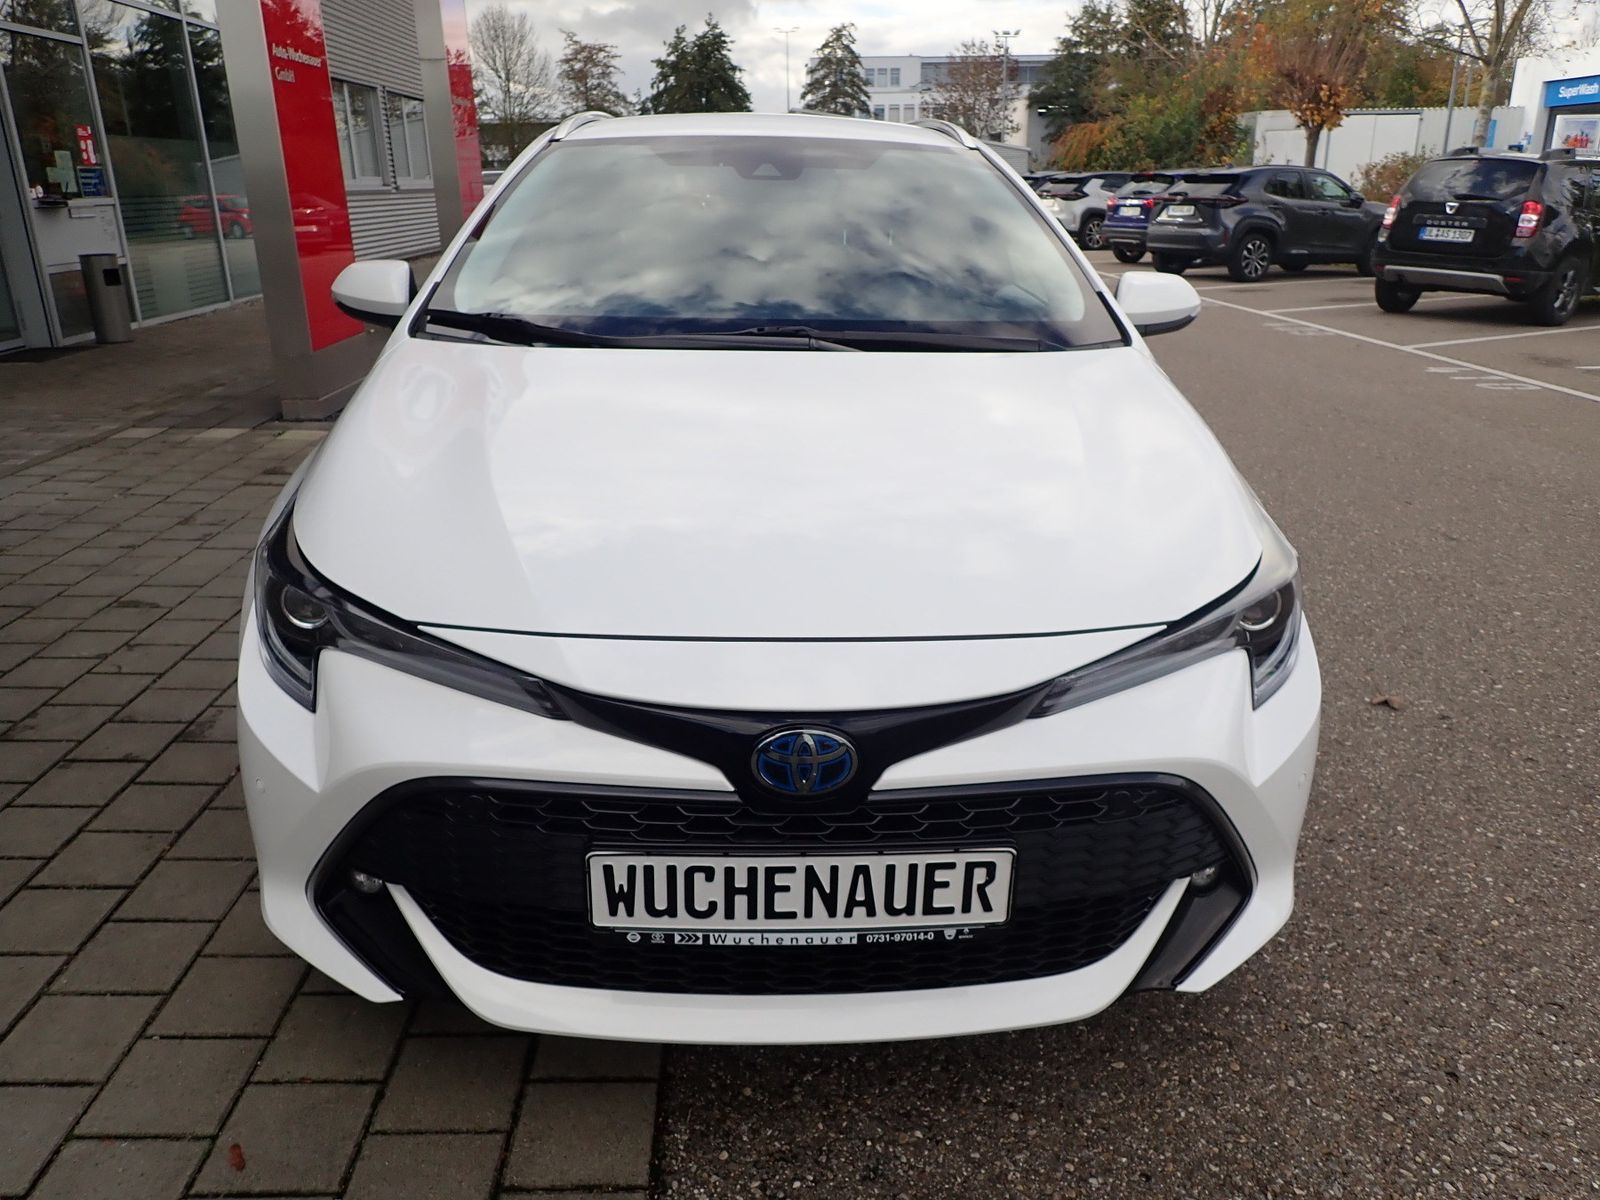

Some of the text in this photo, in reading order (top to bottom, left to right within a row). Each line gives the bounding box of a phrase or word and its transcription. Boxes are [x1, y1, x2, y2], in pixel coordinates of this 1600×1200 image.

[1426, 219, 1469, 227] DUSTER
[602, 861, 997, 920] WUCHENAUER
[711, 932, 935, 945] Wuchenauer 0731-97014-0
